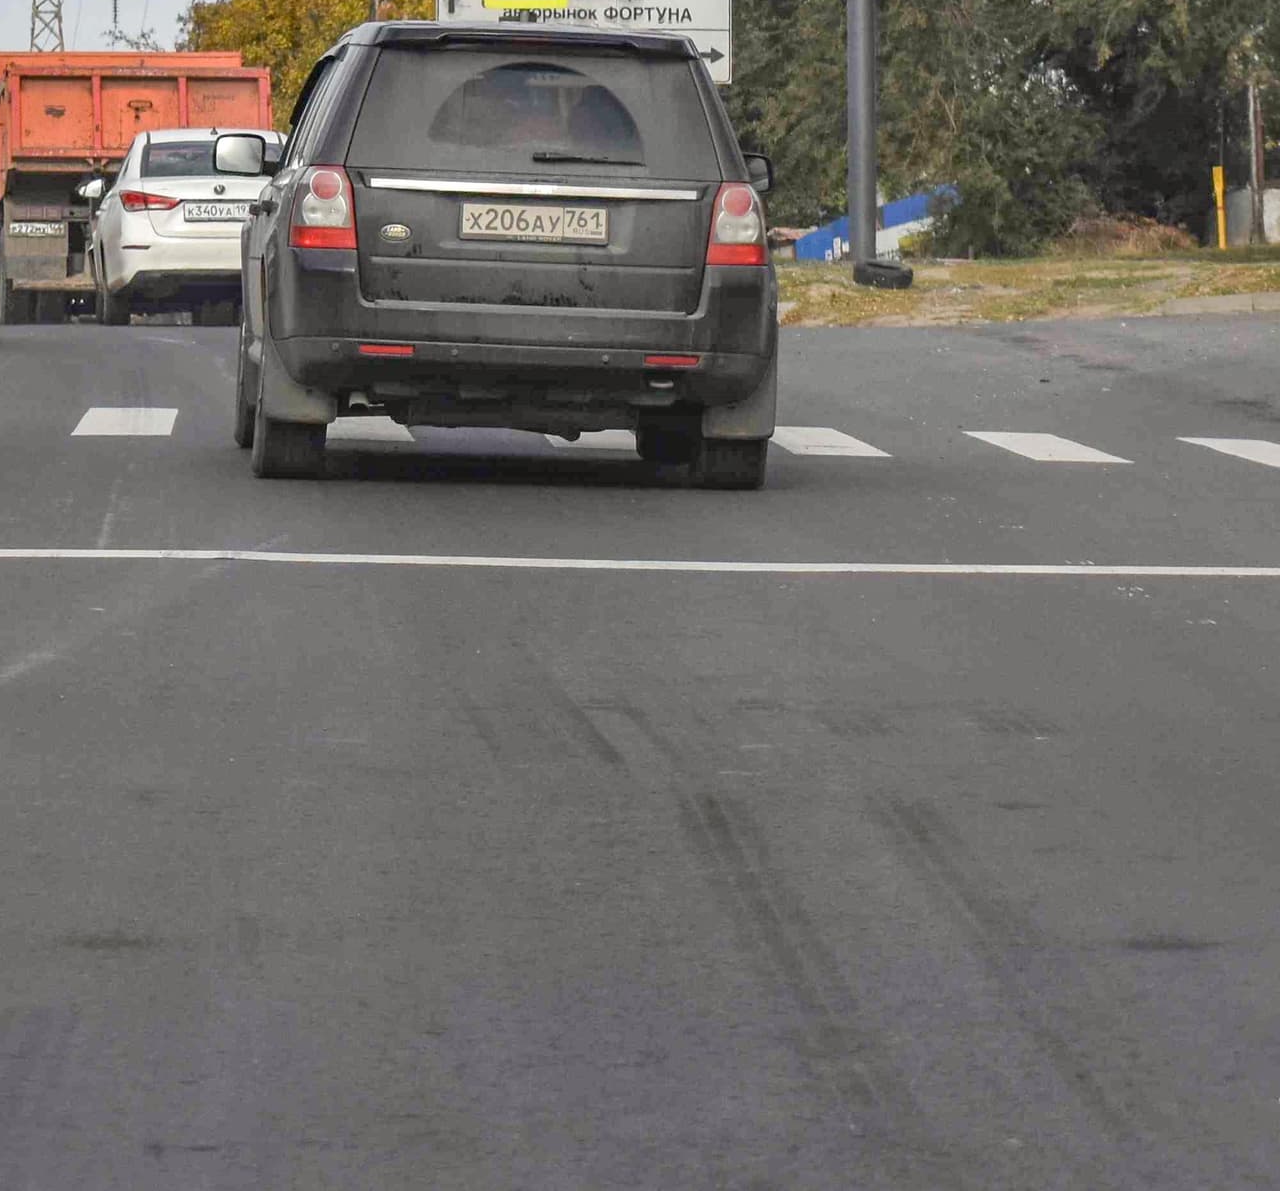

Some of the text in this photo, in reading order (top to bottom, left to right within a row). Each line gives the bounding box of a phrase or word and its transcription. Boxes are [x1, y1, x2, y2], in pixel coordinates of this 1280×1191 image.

[503, 6, 692, 24] аворынок ФОРТУНА
[468, 208, 600, 233] Х206АУ 761
